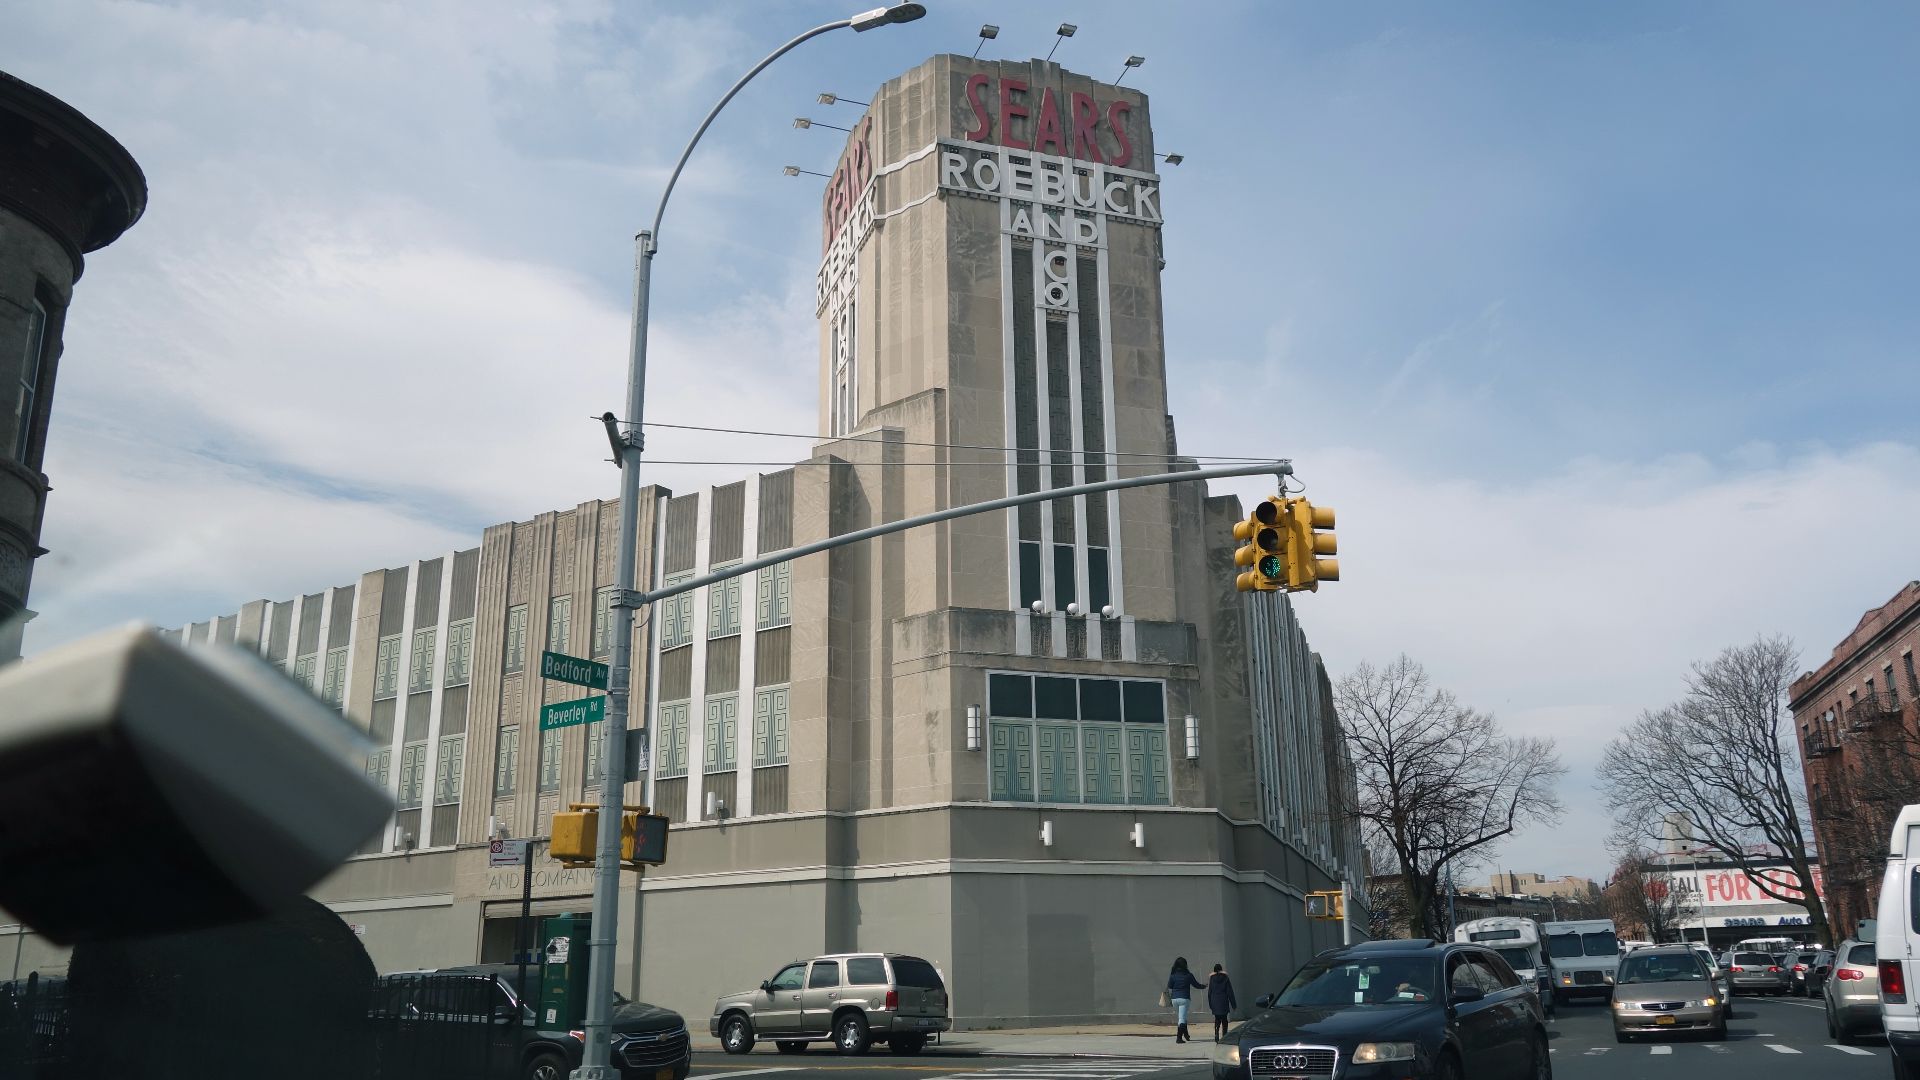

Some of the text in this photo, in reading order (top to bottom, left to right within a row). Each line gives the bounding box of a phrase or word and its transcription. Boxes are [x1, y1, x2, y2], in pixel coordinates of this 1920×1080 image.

[965, 73, 1134, 168] SEARS
[824, 116, 873, 252] SEARS
[941, 151, 1159, 220] ROEBUCK
[1011, 208, 1099, 244] AND
[817, 185, 876, 306] ROEBUCK
[1044, 250, 1070, 306] CO
[545, 655, 592, 683] Bedford
[547, 701, 598, 726] Beverley Rd
[488, 872, 519, 891] AND
[1705, 874, 1753, 902] FOR
[1758, 871, 1825, 899] LEAE
[1779, 916, 1803, 926] Auto
